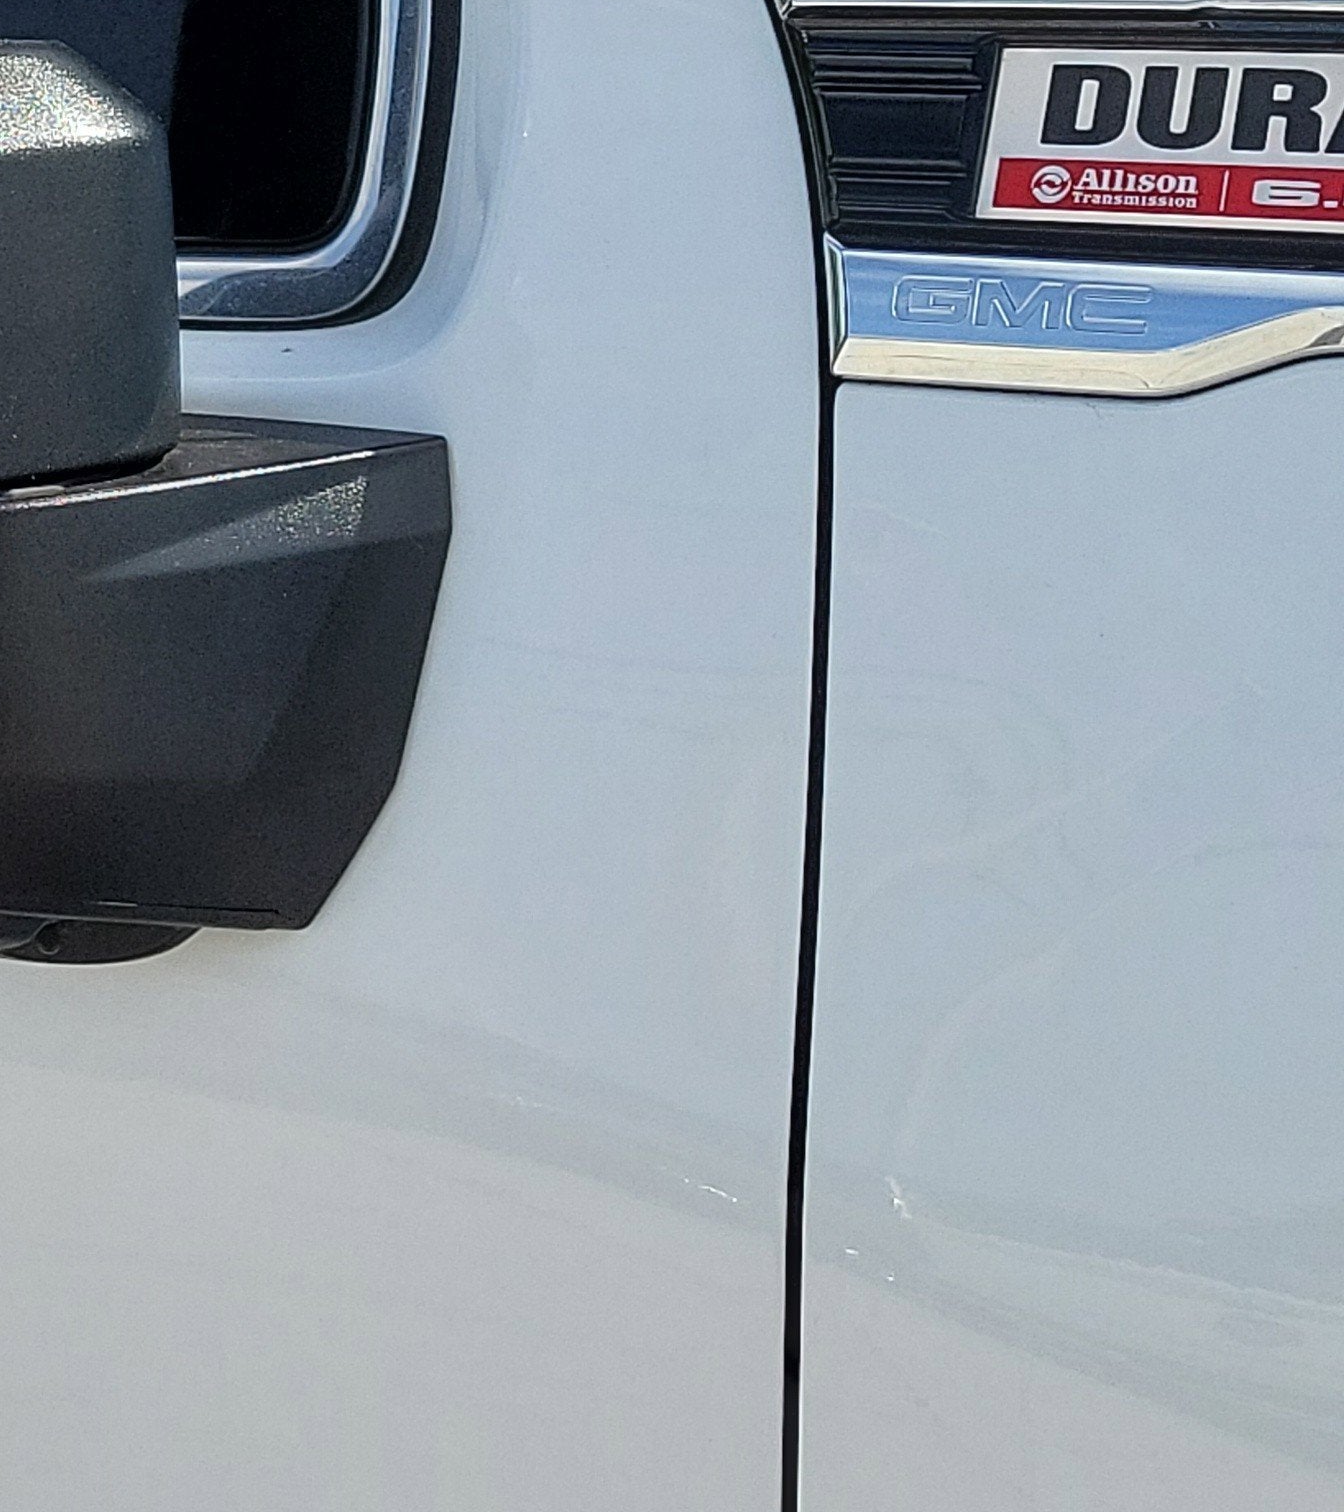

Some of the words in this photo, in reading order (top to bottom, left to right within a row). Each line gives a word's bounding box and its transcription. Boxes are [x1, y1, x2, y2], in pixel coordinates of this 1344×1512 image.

[1072, 167, 1199, 195] Allison
[1252, 178, 1344, 209] 6.
[1072, 190, 1198, 209] Transmission
[890, 275, 1154, 335] GMC
